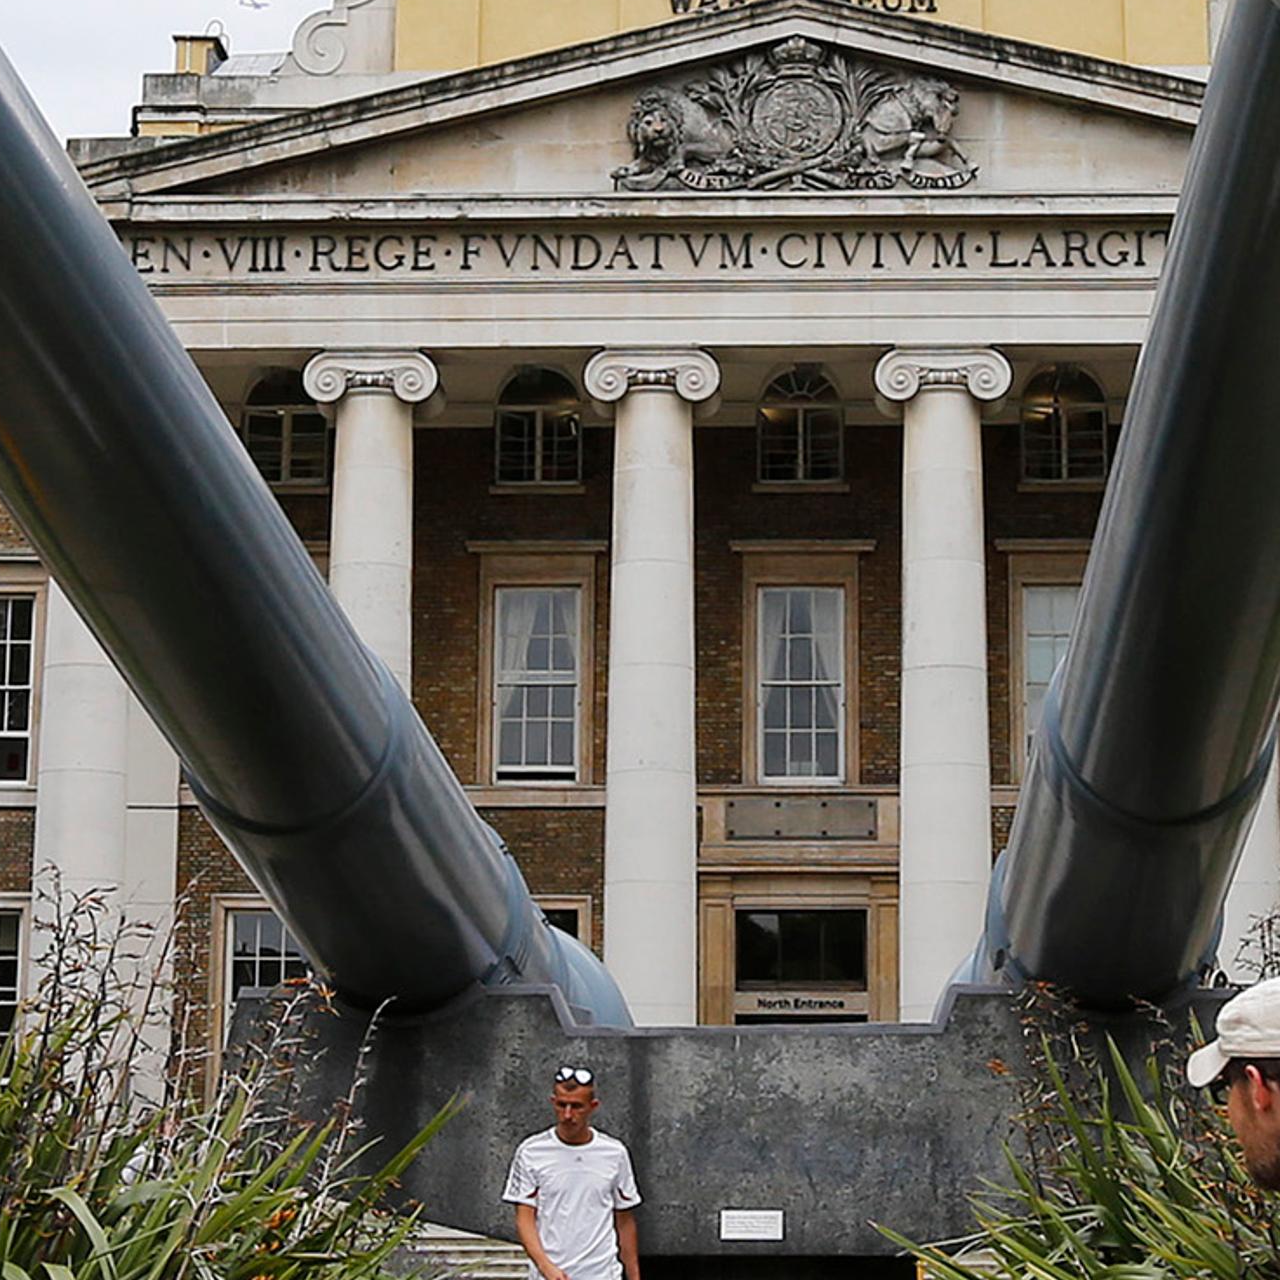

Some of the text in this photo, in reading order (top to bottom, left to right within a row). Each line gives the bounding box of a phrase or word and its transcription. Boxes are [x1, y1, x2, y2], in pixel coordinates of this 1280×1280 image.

[216, 236, 287, 272] VIII
[309, 235, 437, 272] REGE
[459, 232, 755, 271] FVNDATVM
[775, 231, 968, 269] CIVIVM
[757, 998, 845, 1009] North Entrance
